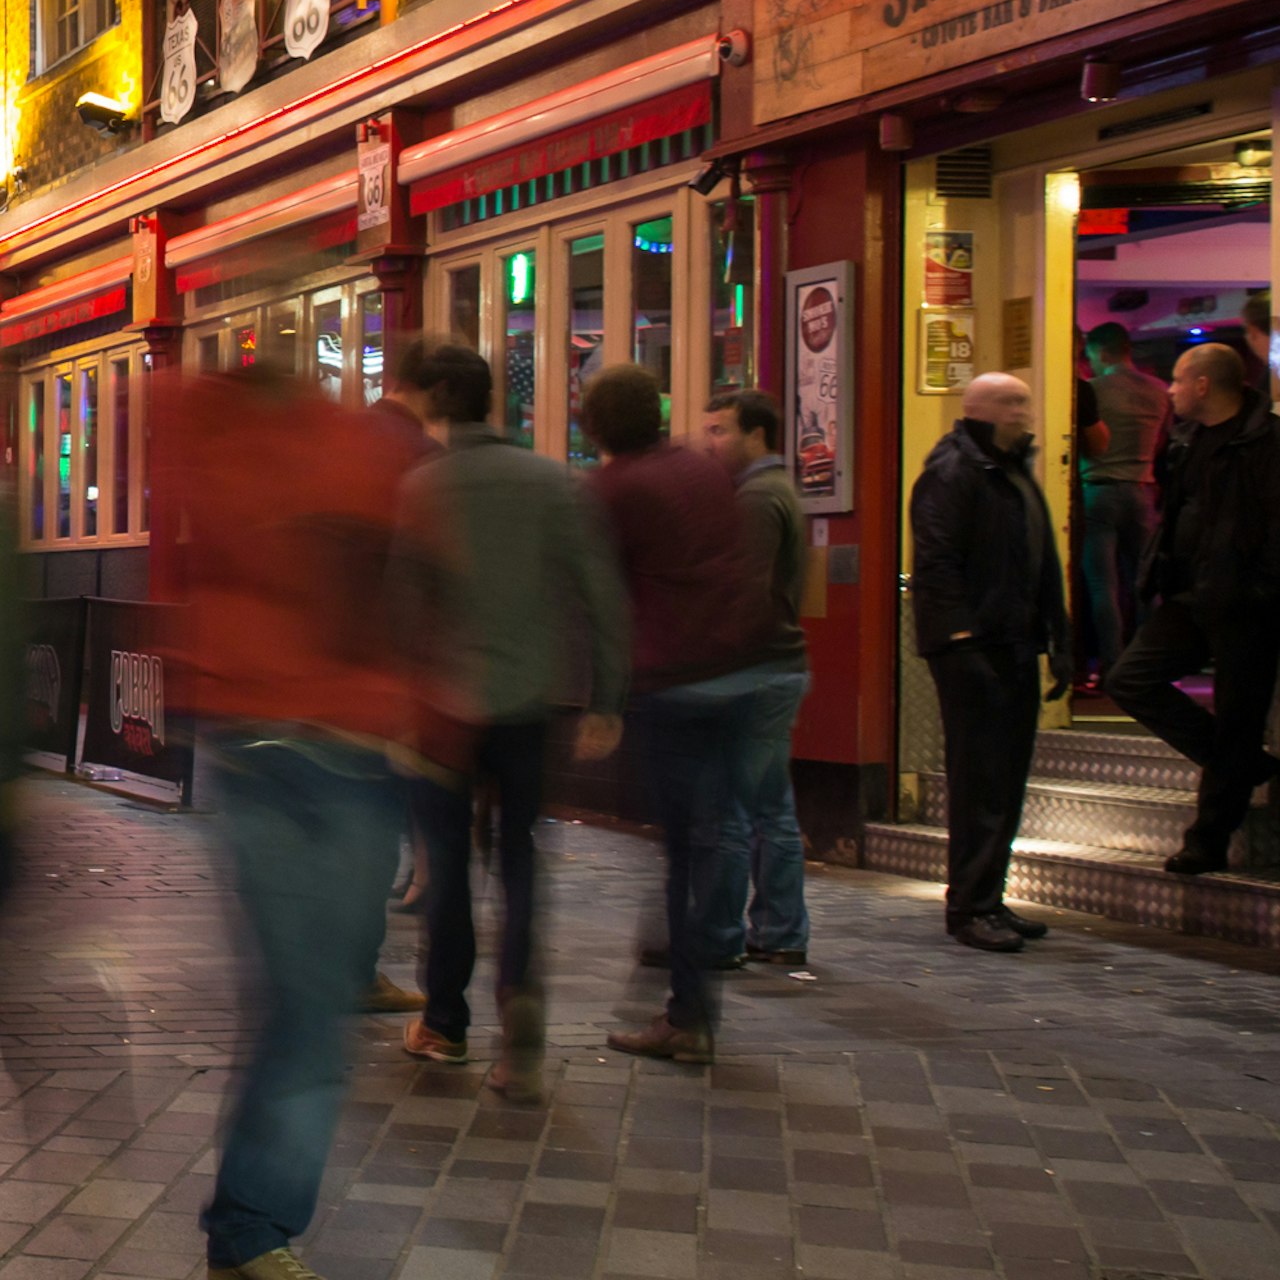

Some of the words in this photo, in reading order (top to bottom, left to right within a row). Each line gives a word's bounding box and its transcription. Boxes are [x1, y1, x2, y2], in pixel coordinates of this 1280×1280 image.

[167, 28, 191, 51] TEXAS
[921, 11, 978, 49] COYOTE
[983, 0, 1014, 30] BAR
[167, 64, 189, 110] 66
[950, 342, 972, 358] 18
[109, 649, 165, 746] COBRA
